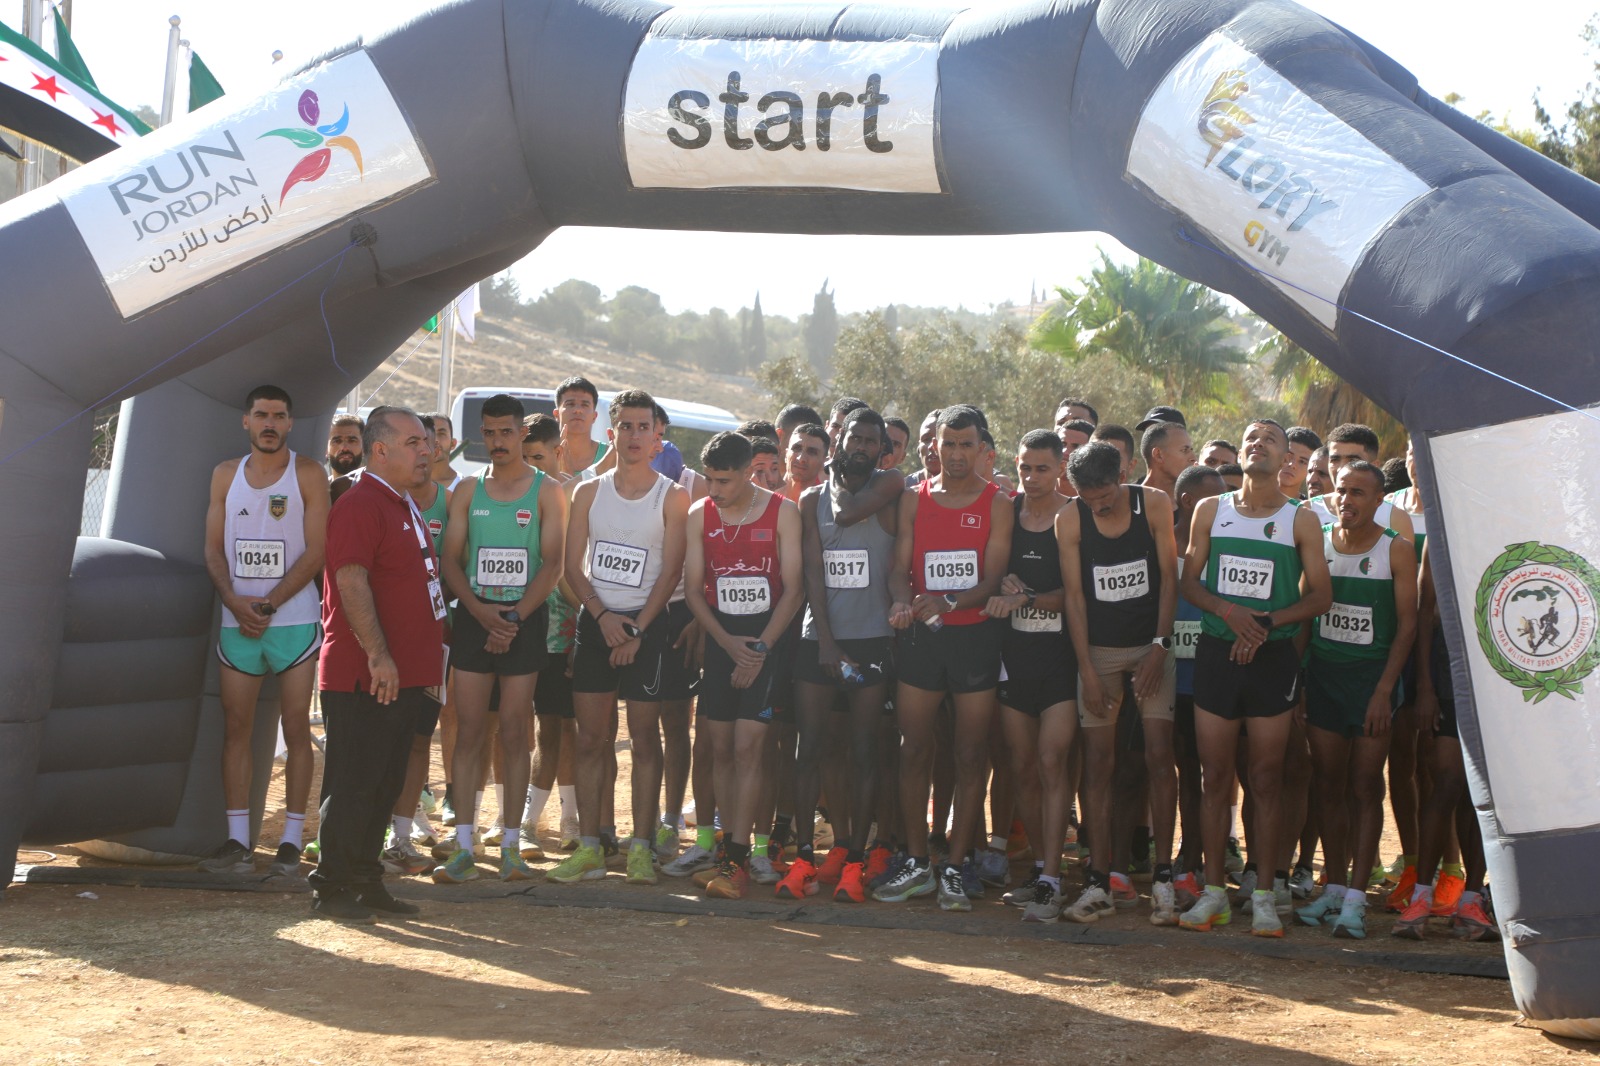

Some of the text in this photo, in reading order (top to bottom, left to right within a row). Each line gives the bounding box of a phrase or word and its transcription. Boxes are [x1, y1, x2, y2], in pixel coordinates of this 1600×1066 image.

[666, 70, 894, 154] start
[107, 129, 246, 216] RUN
[131, 167, 259, 242] JORDAN
[149, 194, 273, 273] أركض للأردن
[1244, 219, 1290, 266] GYM
[238, 551, 279, 566] 10341
[610, 546, 645, 558] RUN JORDAN
[481, 559, 524, 574] 10280
[597, 553, 641, 574] 10297
[710, 556, 772, 577] المغرب
[825, 561, 865, 576] 10317
[928, 562, 975, 578] 10359
[1125, 561, 1146, 572] JORDAN
[1248, 560, 1272, 570] JORDAN
[1098, 570, 1146, 591] 10322
[1221, 566, 1269, 586] 10337
[720, 587, 767, 603] 10354
[1324, 612, 1370, 633] 10332
[1173, 632, 1201, 647] 103
[1497, 616, 1589, 667] ARAB MILITARY SPORTS ASSOCIATION
